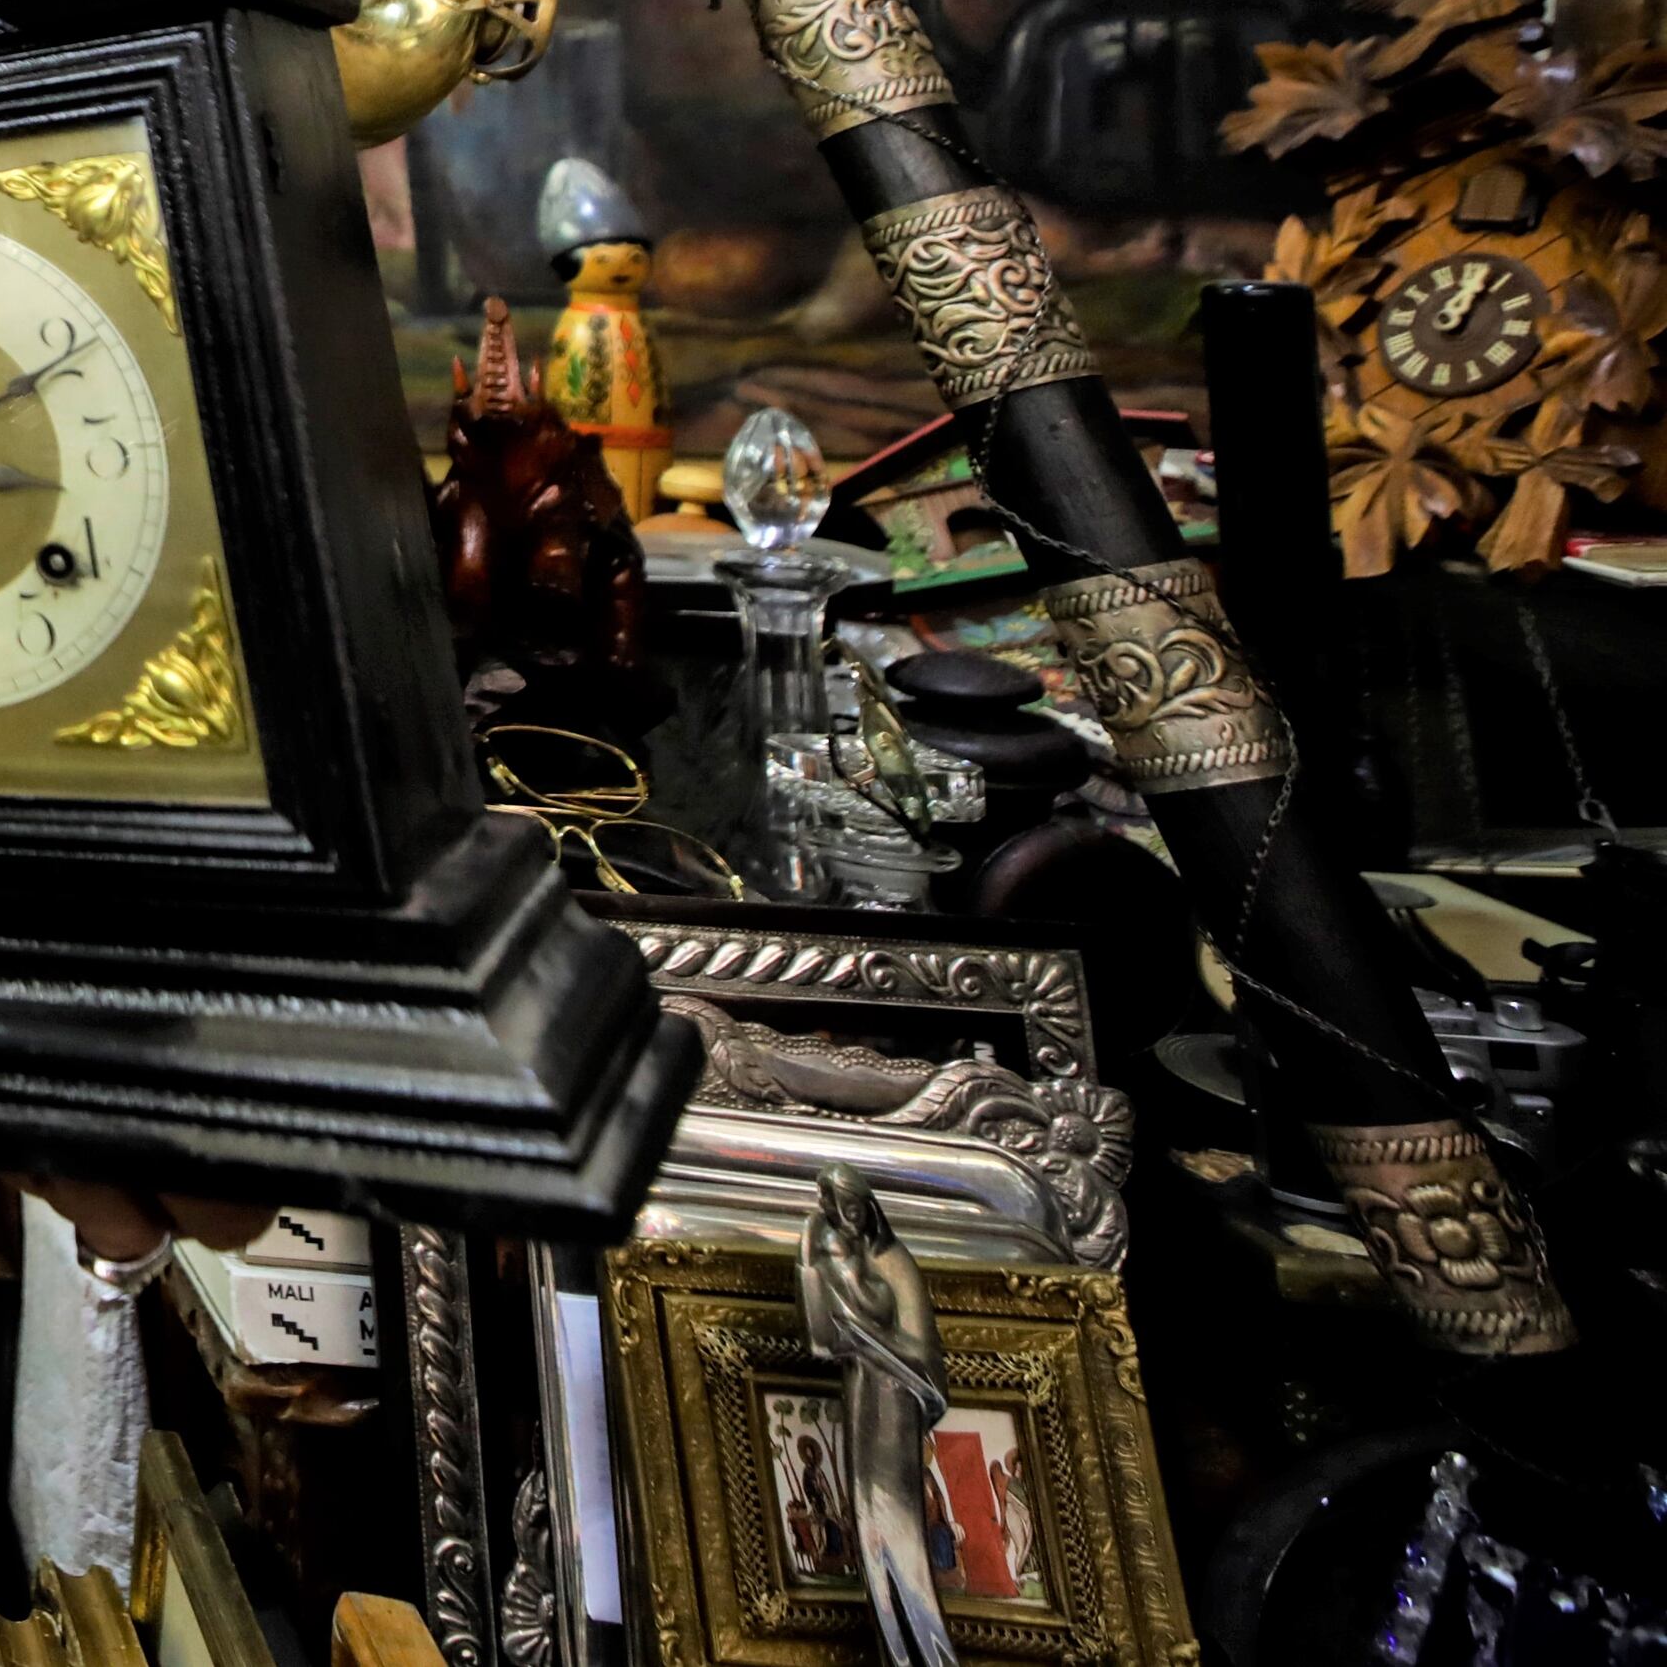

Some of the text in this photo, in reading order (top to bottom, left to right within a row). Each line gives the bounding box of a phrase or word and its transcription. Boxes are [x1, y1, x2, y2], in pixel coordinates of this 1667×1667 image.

[39, 316, 84, 382] 2
[81, 412, 131, 482] 3
[16, 588, 57, 658] 5
[267, 1282, 315, 1302] MALI
